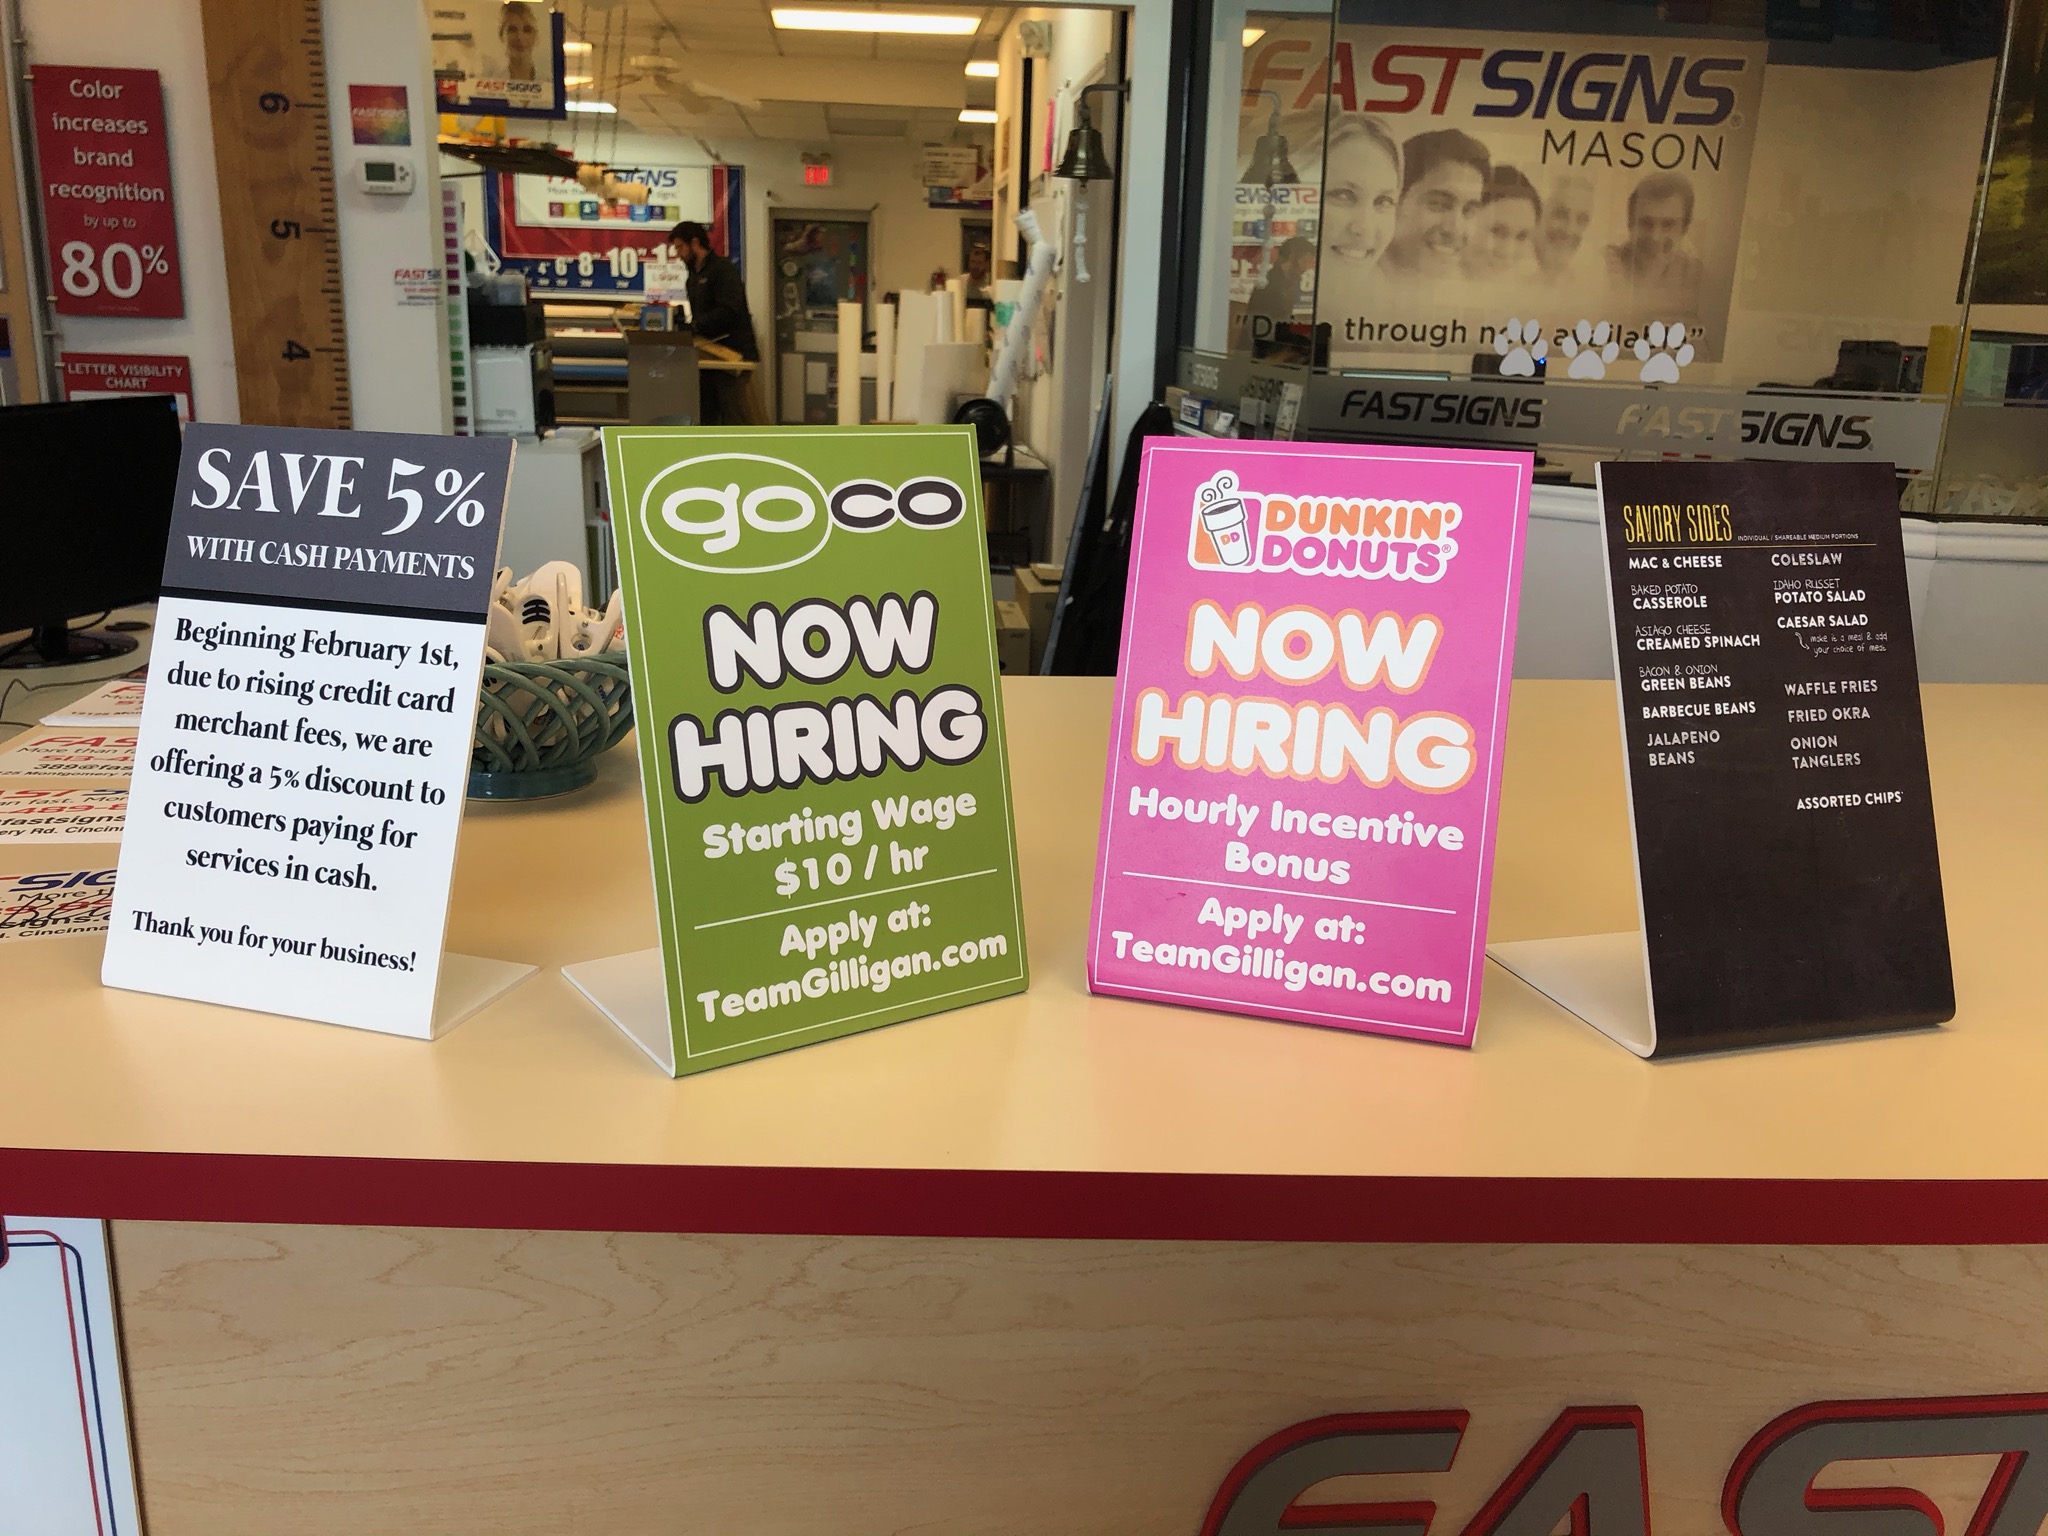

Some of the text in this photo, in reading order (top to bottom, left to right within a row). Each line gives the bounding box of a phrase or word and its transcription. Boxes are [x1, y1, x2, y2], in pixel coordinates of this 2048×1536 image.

[69, 77, 124, 100] Color
[52, 115, 148, 136] increases
[73, 147, 133, 168] brand
[1541, 129, 1725, 172] MASON
[49, 182, 165, 204] recognition
[84, 214, 136, 230] by up to
[271, 219, 300, 240] 5
[61, 240, 169, 300] 80%
[1345, 317, 1467, 348] through
[282, 340, 310, 362] 4
[67, 363, 183, 379] LETTER VISIBILITY
[105, 377, 149, 390] CHART
[1340, 390, 1544, 430] FASTSIGNS
[190, 447, 486, 535] SAVE 5%
[1265, 500, 1456, 541] DUNKIN'
[1623, 504, 1733, 543] SAVORY SIDES
[1220, 531, 1241, 546] DD
[1737, 534, 1770, 542] INDIVIDUAL
[1774, 533, 1808, 542] SHAREABLE
[1807, 533, 1831, 541] MEDIUM
[1830, 532, 1860, 541] PORTIONS
[187, 535, 476, 580] WITH CASH PAYMENTS
[1628, 555, 1724, 570] MAC & CHEESE
[1771, 552, 1844, 567] COLESLAW
[1631, 583, 1699, 597] BAKED POTATO
[1773, 578, 1841, 591] IDAHO RUSSET
[1633, 596, 1709, 611] CASSEROLE
[1774, 589, 1867, 605] POTATO SALAD
[1635, 624, 1712, 638] ASIAGO CHEESE
[1777, 613, 1870, 630] CAESAR SALAD
[174, 618, 460, 670] Beginning February 1st,
[703, 590, 939, 694] NOW
[1184, 599, 1444, 695] NOW
[1636, 634, 1762, 652] CREAMED SPINACH
[1810, 633, 1829, 643] make
[1831, 633, 1838, 642] it
[1847, 632, 1864, 642] meal
[1866, 631, 1874, 641] &
[1875, 631, 1889, 642] add
[1813, 645, 1831, 659] your
[1832, 643, 1855, 654] choice
[1856, 642, 1866, 653] of
[1639, 663, 1719, 678] BACON & ONION
[167, 660, 455, 714] due to rising credit card
[1640, 675, 1732, 692] GREEN BEANS
[1784, 679, 1880, 697] WAFFLE FRIES
[1642, 701, 1757, 720] BARBECUE BEANS
[1787, 707, 1872, 724] FRIED OKRA
[29, 736, 139, 748] FAS
[175, 710, 433, 757] merchant fees, we are
[668, 684, 988, 804] HIRING
[1131, 687, 1477, 795] HIRING
[1647, 729, 1721, 747] JALAPENO
[1790, 735, 1839, 751] ONION
[33, 763, 134, 771] 389@fas
[1648, 750, 1696, 767] BEANS
[1791, 752, 1862, 770] TANGLERS
[150, 748, 446, 806] offering a 5% discount to
[1796, 795, 1862, 811] ASSORTED
[164, 800, 418, 851] customers paying for
[702, 792, 978, 859] Starting Wage
[1128, 785, 1465, 852] Hourly Incentive
[0, 828, 27, 837] ery
[30, 827, 58, 835] Rd.
[185, 848, 378, 892] services in cash.
[774, 840, 930, 899] $10 / hr
[1223, 841, 1352, 886] Bonus
[8, 868, 117, 893] SIG
[17, 892, 87, 902] More
[18, 925, 109, 938] Cincinna
[779, 901, 932, 960] Apply at:
[1197, 897, 1367, 946] Apply at:
[132, 909, 195, 939] Thank
[197, 924, 233, 947] you
[238, 924, 268, 949] for
[269, 934, 317, 957] your
[320, 937, 416, 973] business!
[1111, 930, 1453, 1004] TeamGilligan.com
[696, 934, 1008, 1022] TeamGilligan.com
